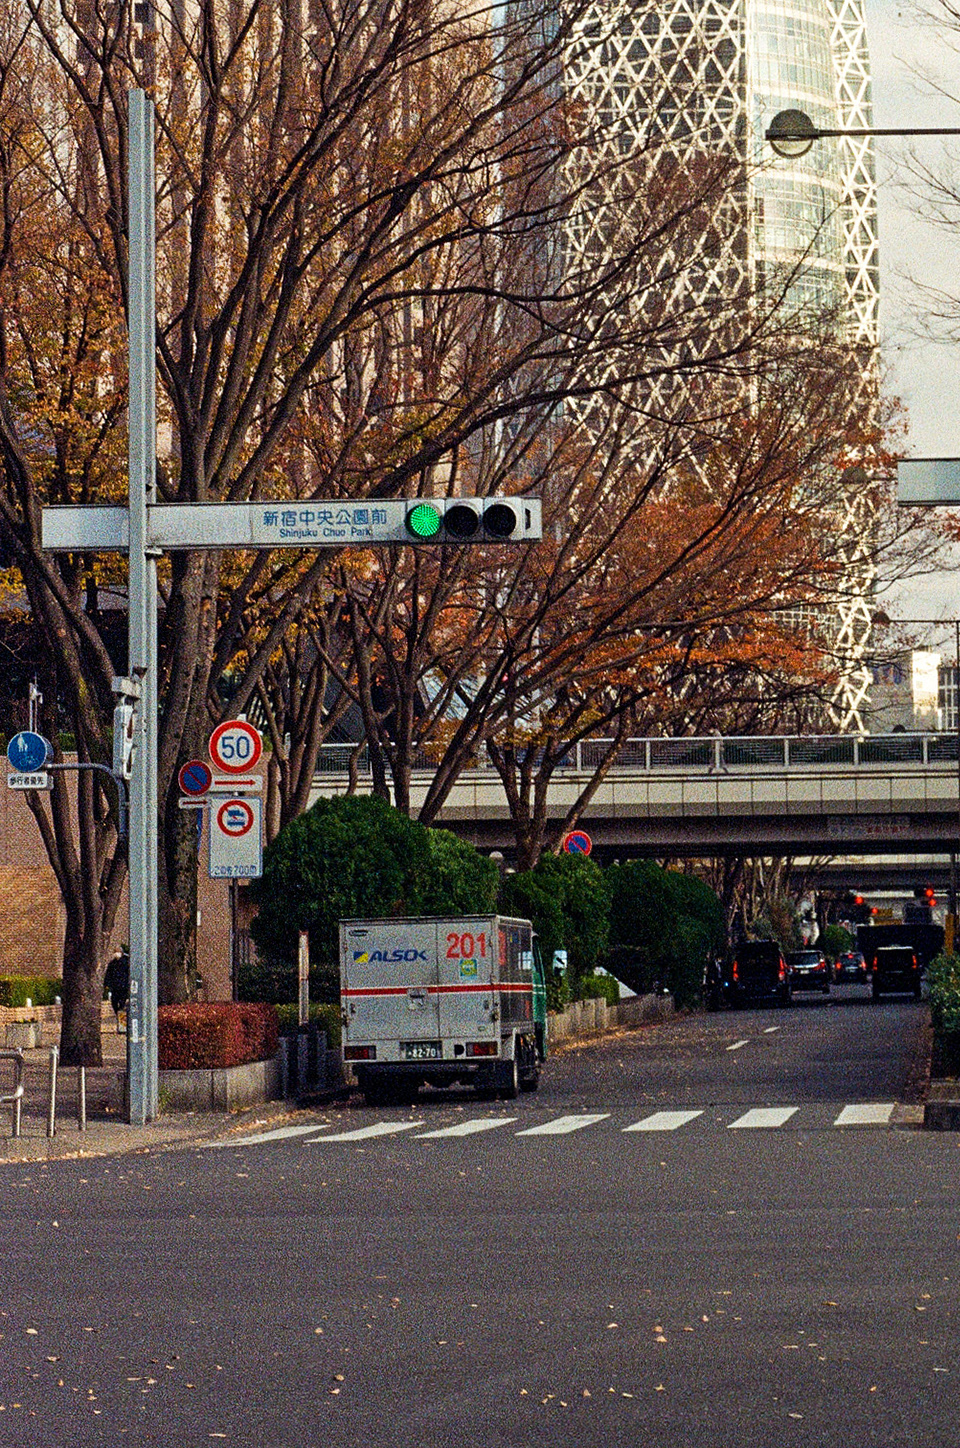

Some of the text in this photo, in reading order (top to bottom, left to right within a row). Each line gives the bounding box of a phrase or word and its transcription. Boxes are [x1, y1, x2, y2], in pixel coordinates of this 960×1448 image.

[263, 508, 387, 527] 新宿中央公園前
[280, 526, 372, 539] Shinjuku Chuo Park
[222, 736, 250, 759] 50
[370, 949, 427, 962] ALSOK
[446, 933, 486, 959] 201
